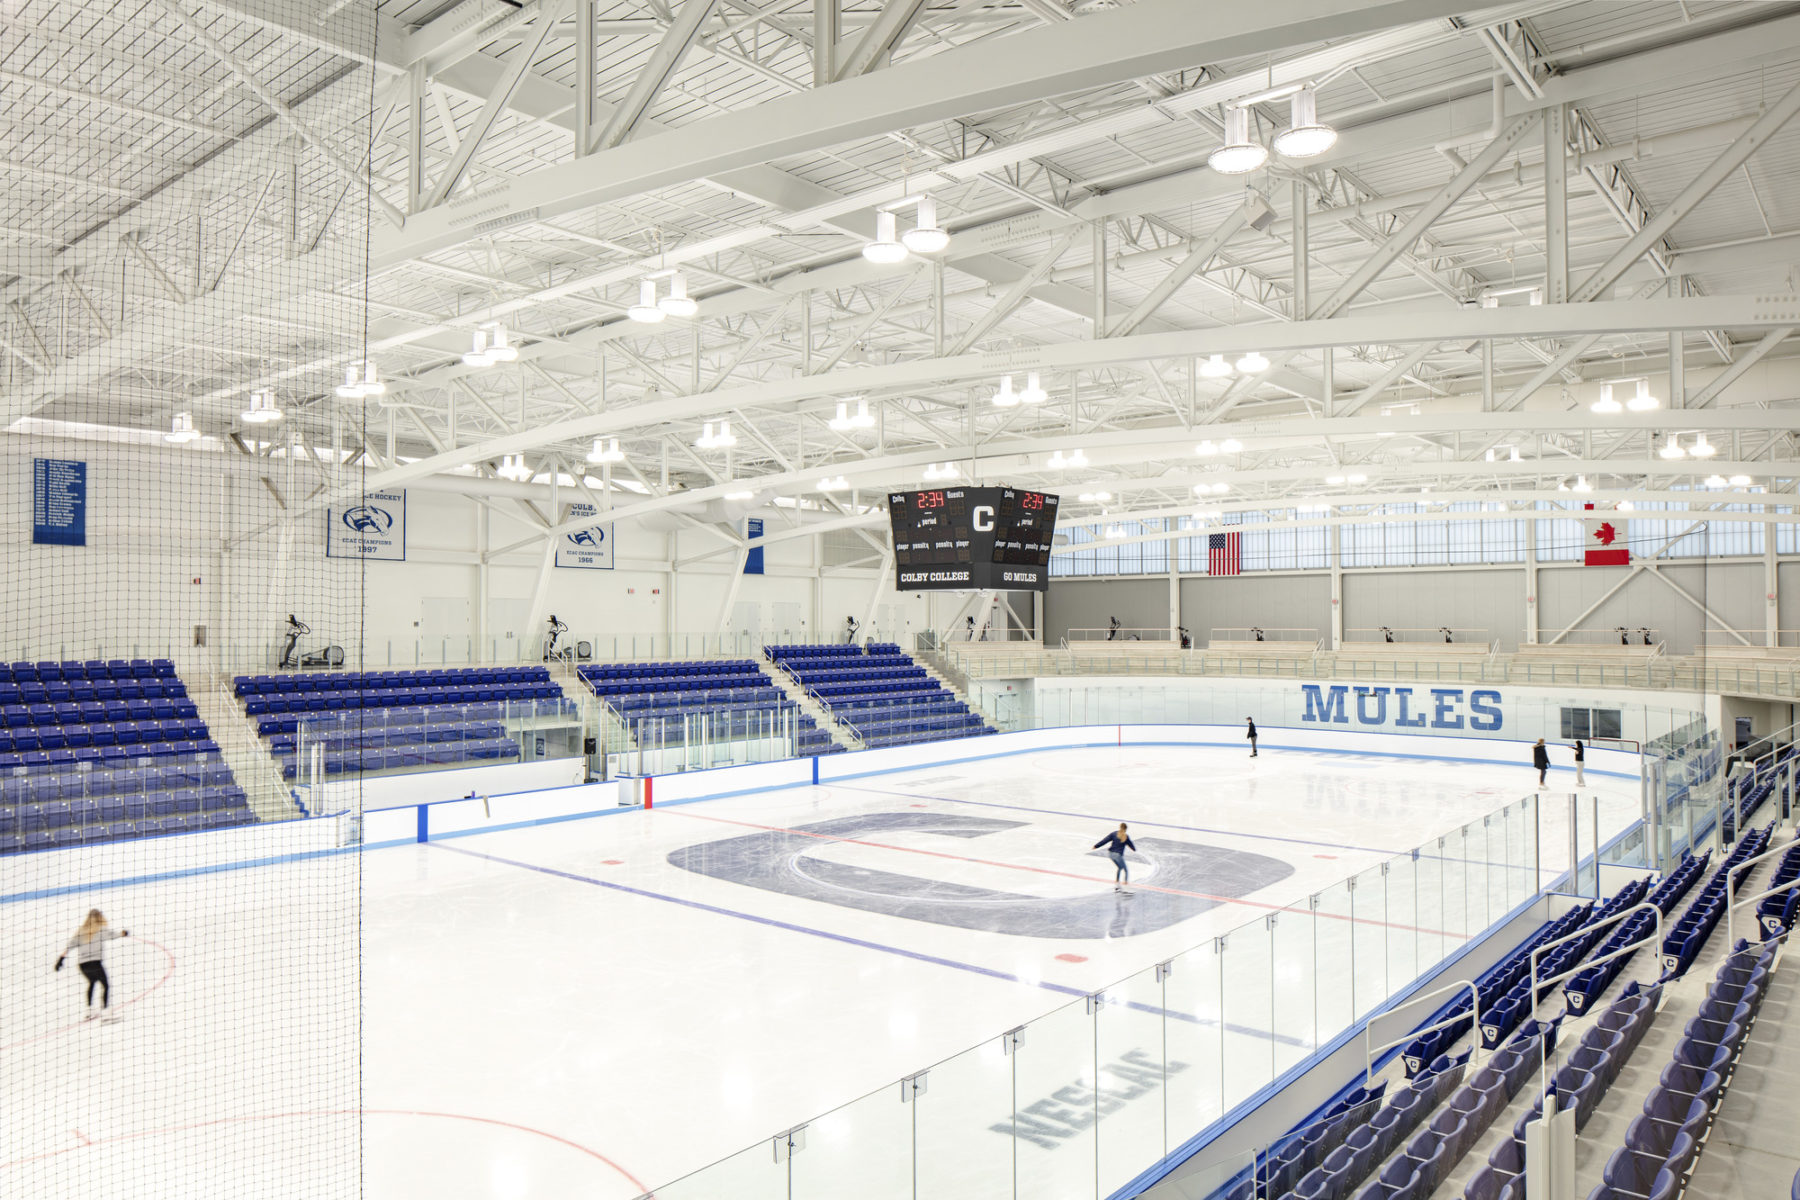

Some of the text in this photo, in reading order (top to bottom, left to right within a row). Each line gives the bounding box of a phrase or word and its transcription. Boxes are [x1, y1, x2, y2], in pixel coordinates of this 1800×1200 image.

[374, 493, 402, 502] HOCKEY
[917, 491, 945, 509] 2:34
[1022, 492, 1044, 509] 2:34
[921, 518, 937, 527] period
[973, 505, 995, 532] C
[900, 571, 970, 582] COLBY COLLEGE
[1003, 572, 1037, 583] GO MULES
[1301, 684, 1504, 731] MULES
